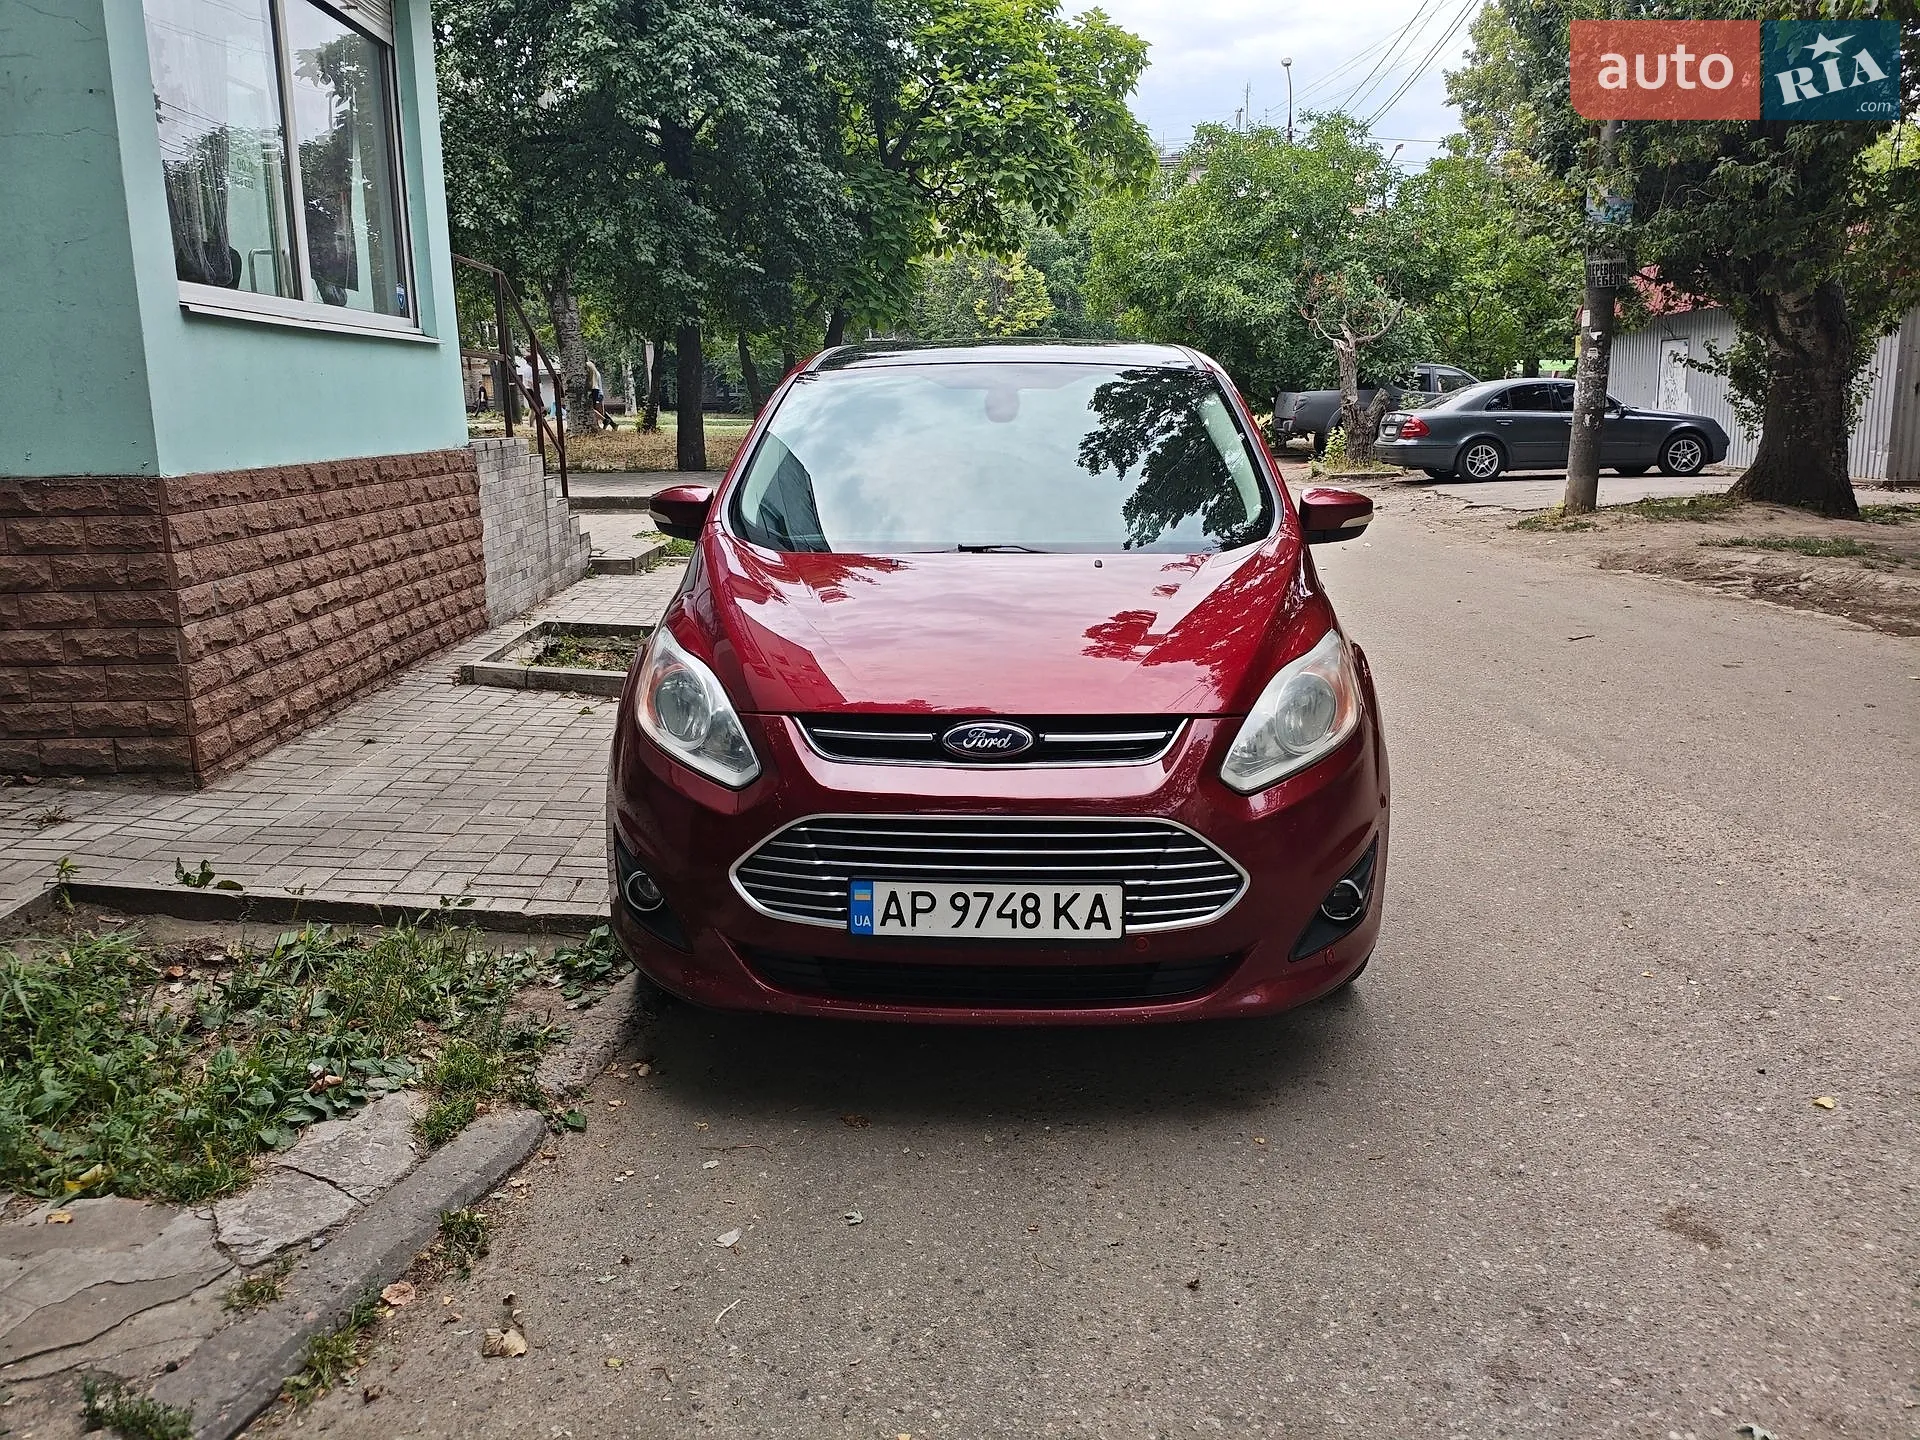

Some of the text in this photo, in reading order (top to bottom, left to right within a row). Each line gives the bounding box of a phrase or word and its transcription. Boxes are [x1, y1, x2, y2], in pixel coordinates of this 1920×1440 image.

[963, 728, 1013, 749] Ford
[879, 890, 1112, 931] AP 9748 KA
[854, 915, 872, 928] UA
